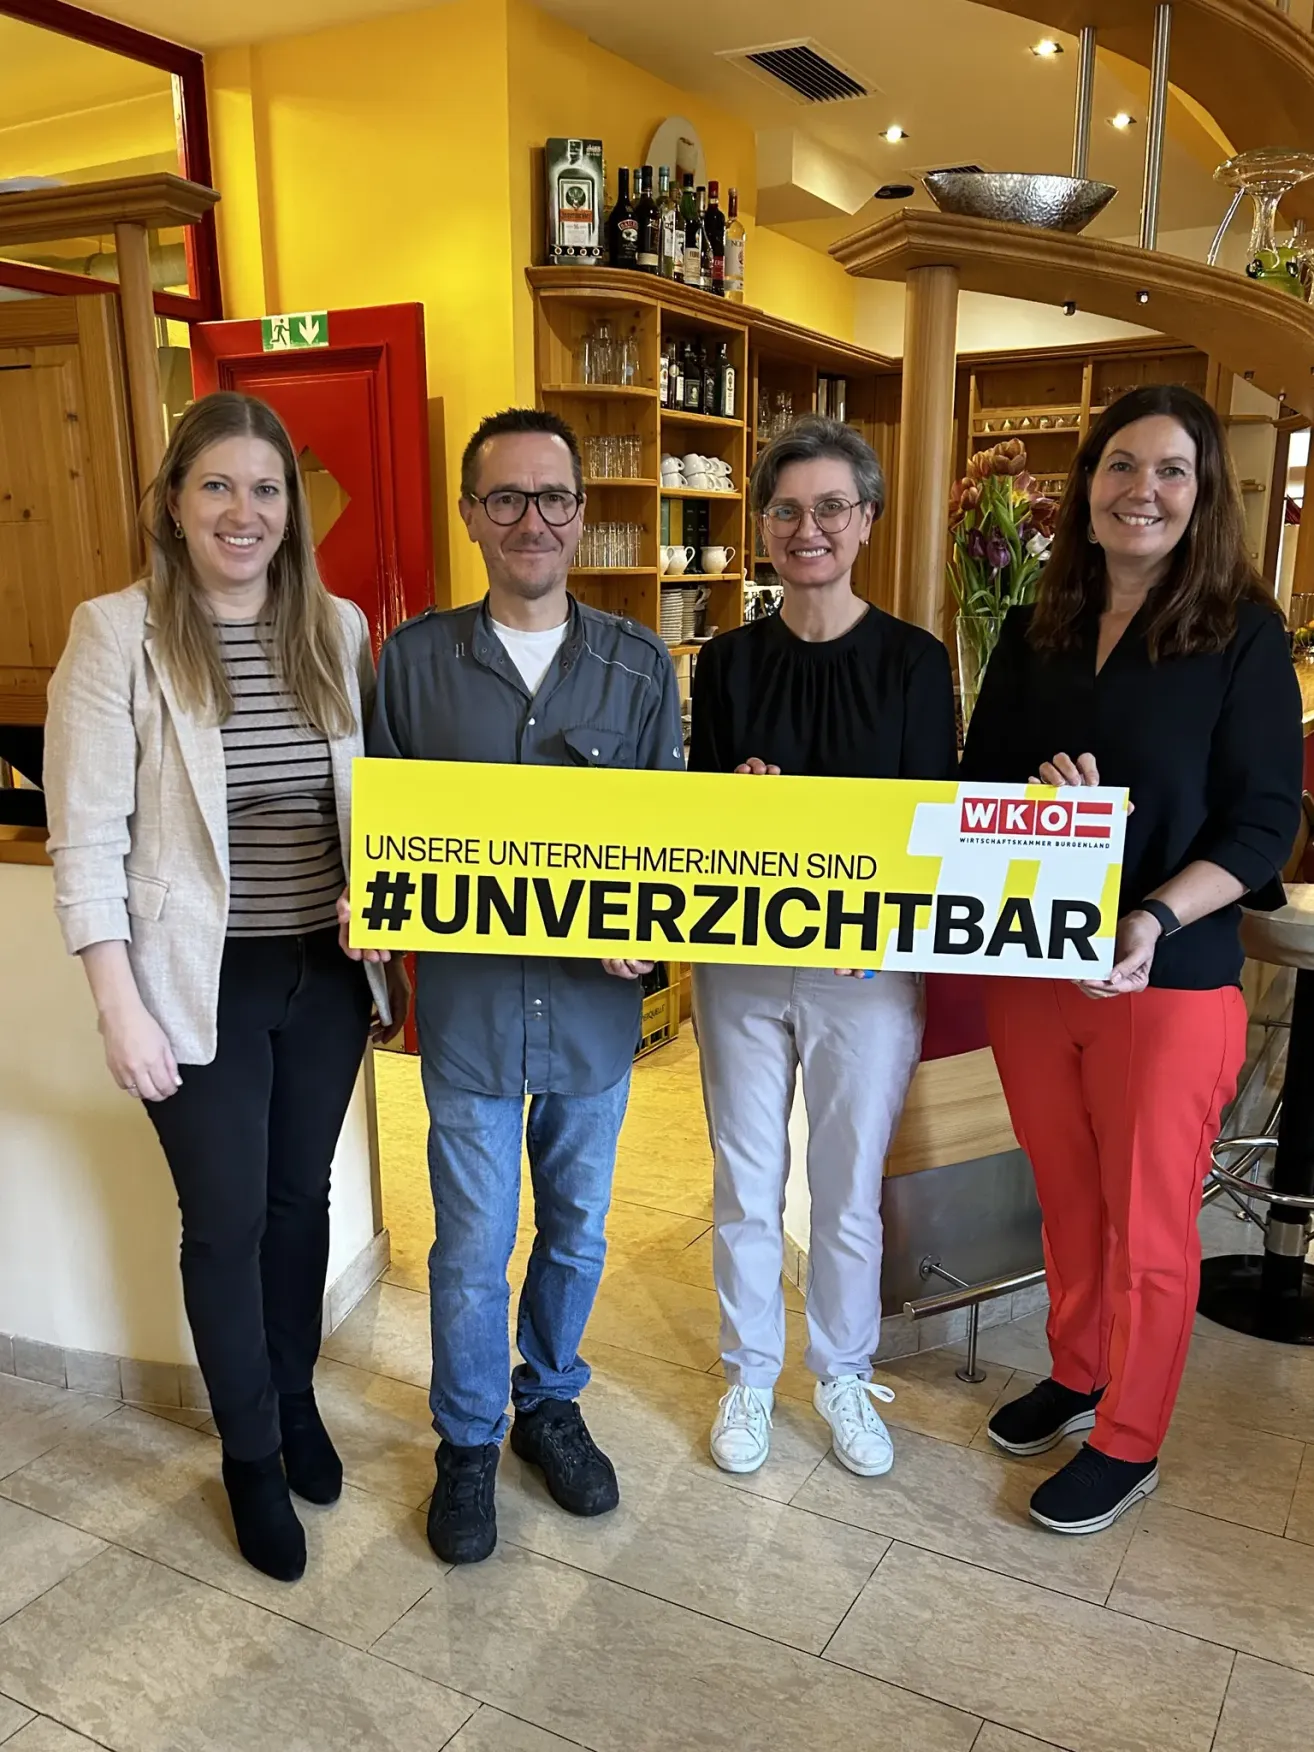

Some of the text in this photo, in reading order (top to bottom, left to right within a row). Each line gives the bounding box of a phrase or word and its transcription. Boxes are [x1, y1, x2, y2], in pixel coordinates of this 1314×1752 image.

[964, 802, 1069, 832] WKO
[365, 834, 877, 881] UNSERE UNTERNEHMER:INNEN SIND
[960, 837, 1111, 850] WIRTSCHAFTSKAMMER BURGENLAND
[361, 870, 1100, 962] #UNVERZICHTBAR
[642, 1004, 666, 1021] ERQUELLE
